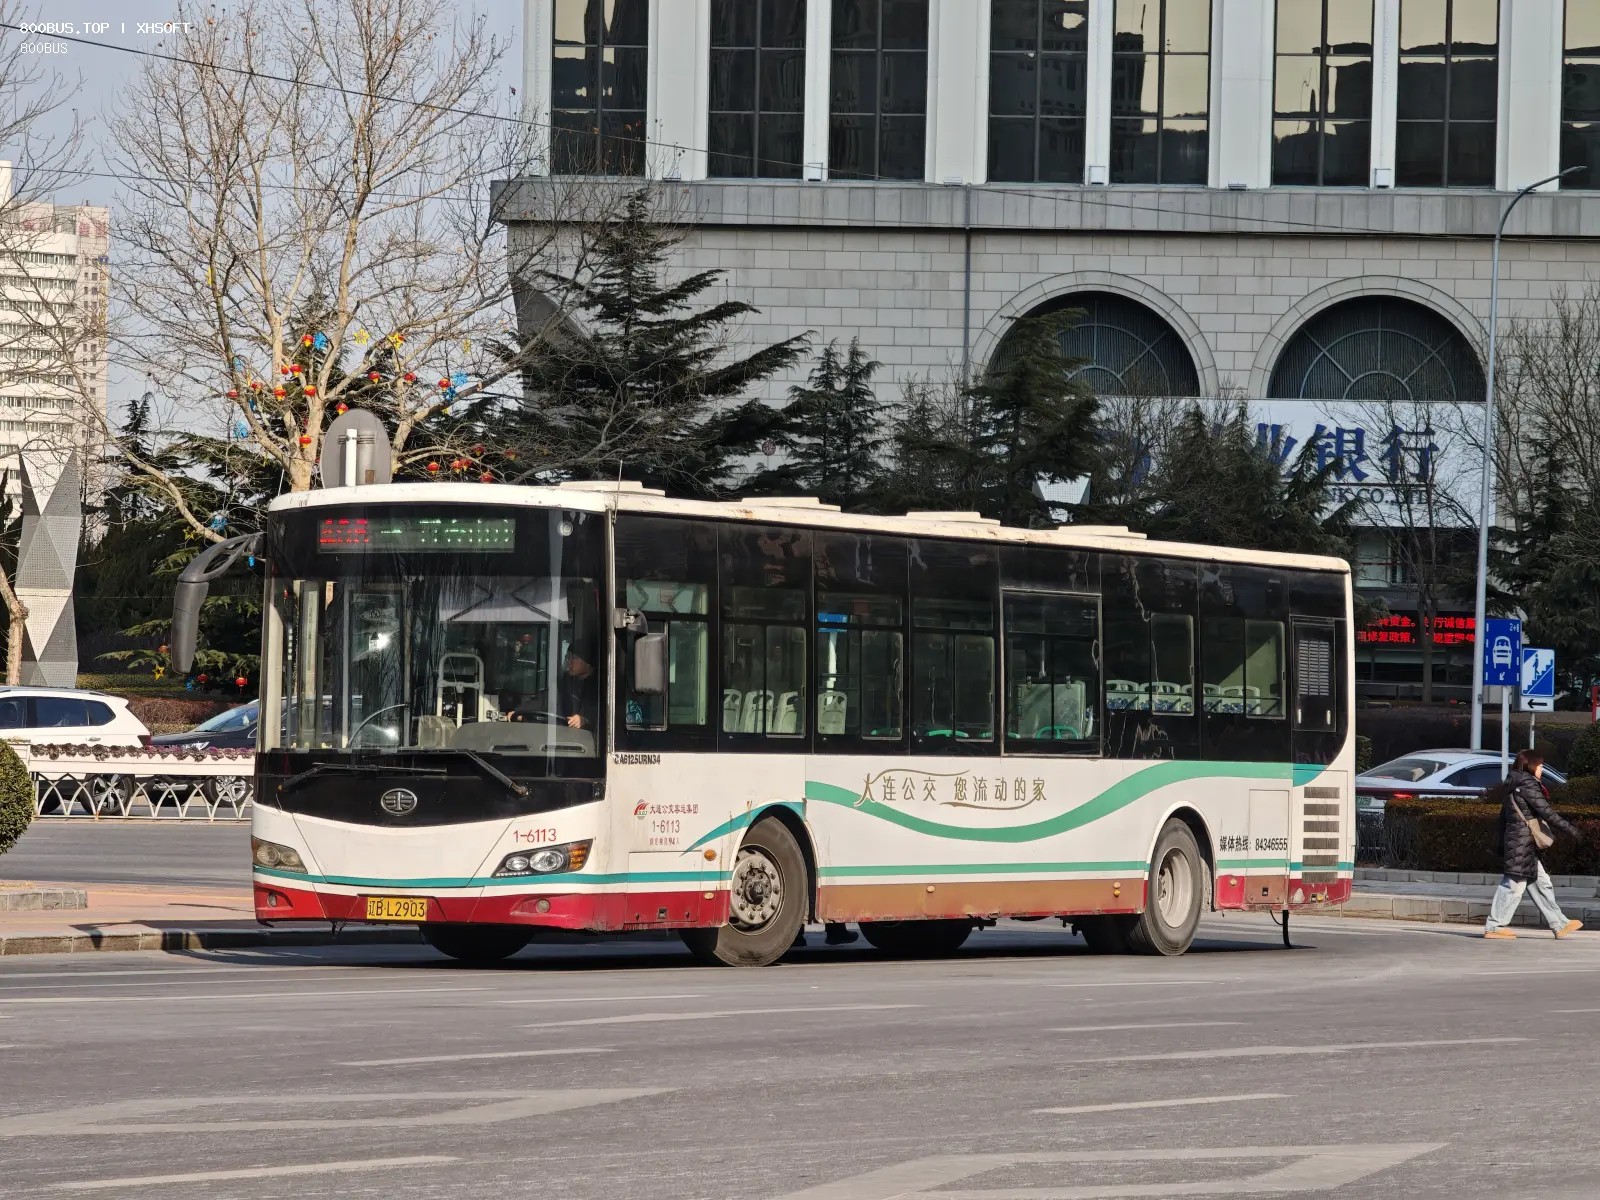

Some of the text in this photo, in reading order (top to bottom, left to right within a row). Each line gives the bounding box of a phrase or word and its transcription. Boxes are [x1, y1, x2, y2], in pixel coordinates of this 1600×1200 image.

[613, 753, 661, 765] CA6125URN34
[854, 773, 1048, 806] 大连公交 您流动的家
[652, 819, 680, 833] 1-6113
[513, 828, 557, 843] 1-6113
[1255, 837, 1288, 851] 84346555
